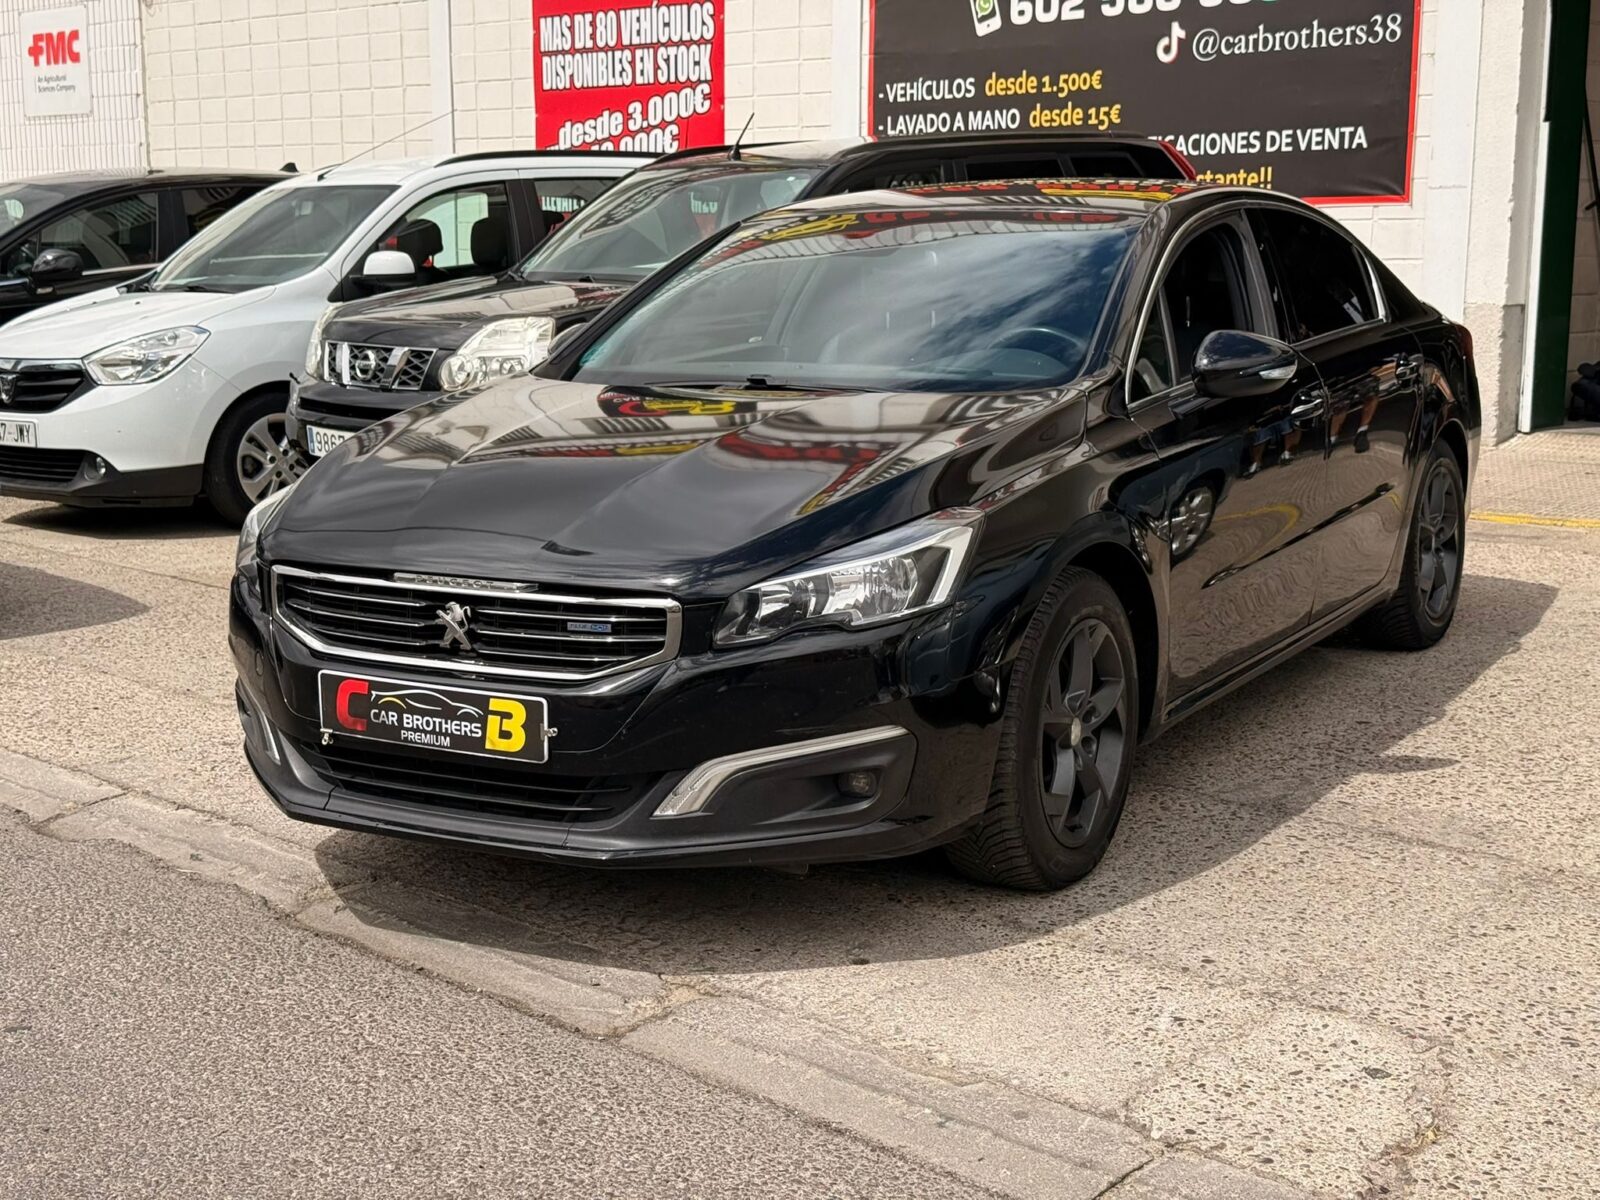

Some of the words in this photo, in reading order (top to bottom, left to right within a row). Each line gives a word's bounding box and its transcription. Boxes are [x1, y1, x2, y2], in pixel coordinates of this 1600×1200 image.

[539, 14, 572, 53] MAS
[573, 12, 594, 50] DE
[595, 10, 617, 48] 80
[619, 1, 715, 46] VEHÍCULOS
[1192, 13, 1402, 62] @carbrothers38
[28, 29, 81, 67] FMC
[541, 49, 633, 91] DISPONIBLES
[635, 48, 654, 85] EN
[656, 43, 712, 84] STOCK
[886, 77, 975, 103] VEHÍCULOS
[985, 69, 1037, 96] desde
[1042, 70, 1102, 98] 1.500€
[558, 109, 624, 150] desde
[627, 83, 711, 132] 3.000€
[887, 112, 950, 135] LAVADO
[953, 113, 964, 132] A
[968, 108, 1021, 131] MANO
[1029, 101, 1083, 128] desde
[1088, 104, 1121, 130] 15€
[1266, 130, 1293, 153] DE
[1296, 126, 1368, 151] VENTA
[415, 575, 494, 590] PEUGEOT
[370, 708, 398, 727] CAR
[403, 713, 482, 738] BROTHERS
[401, 729, 450, 748] PREMIUM
